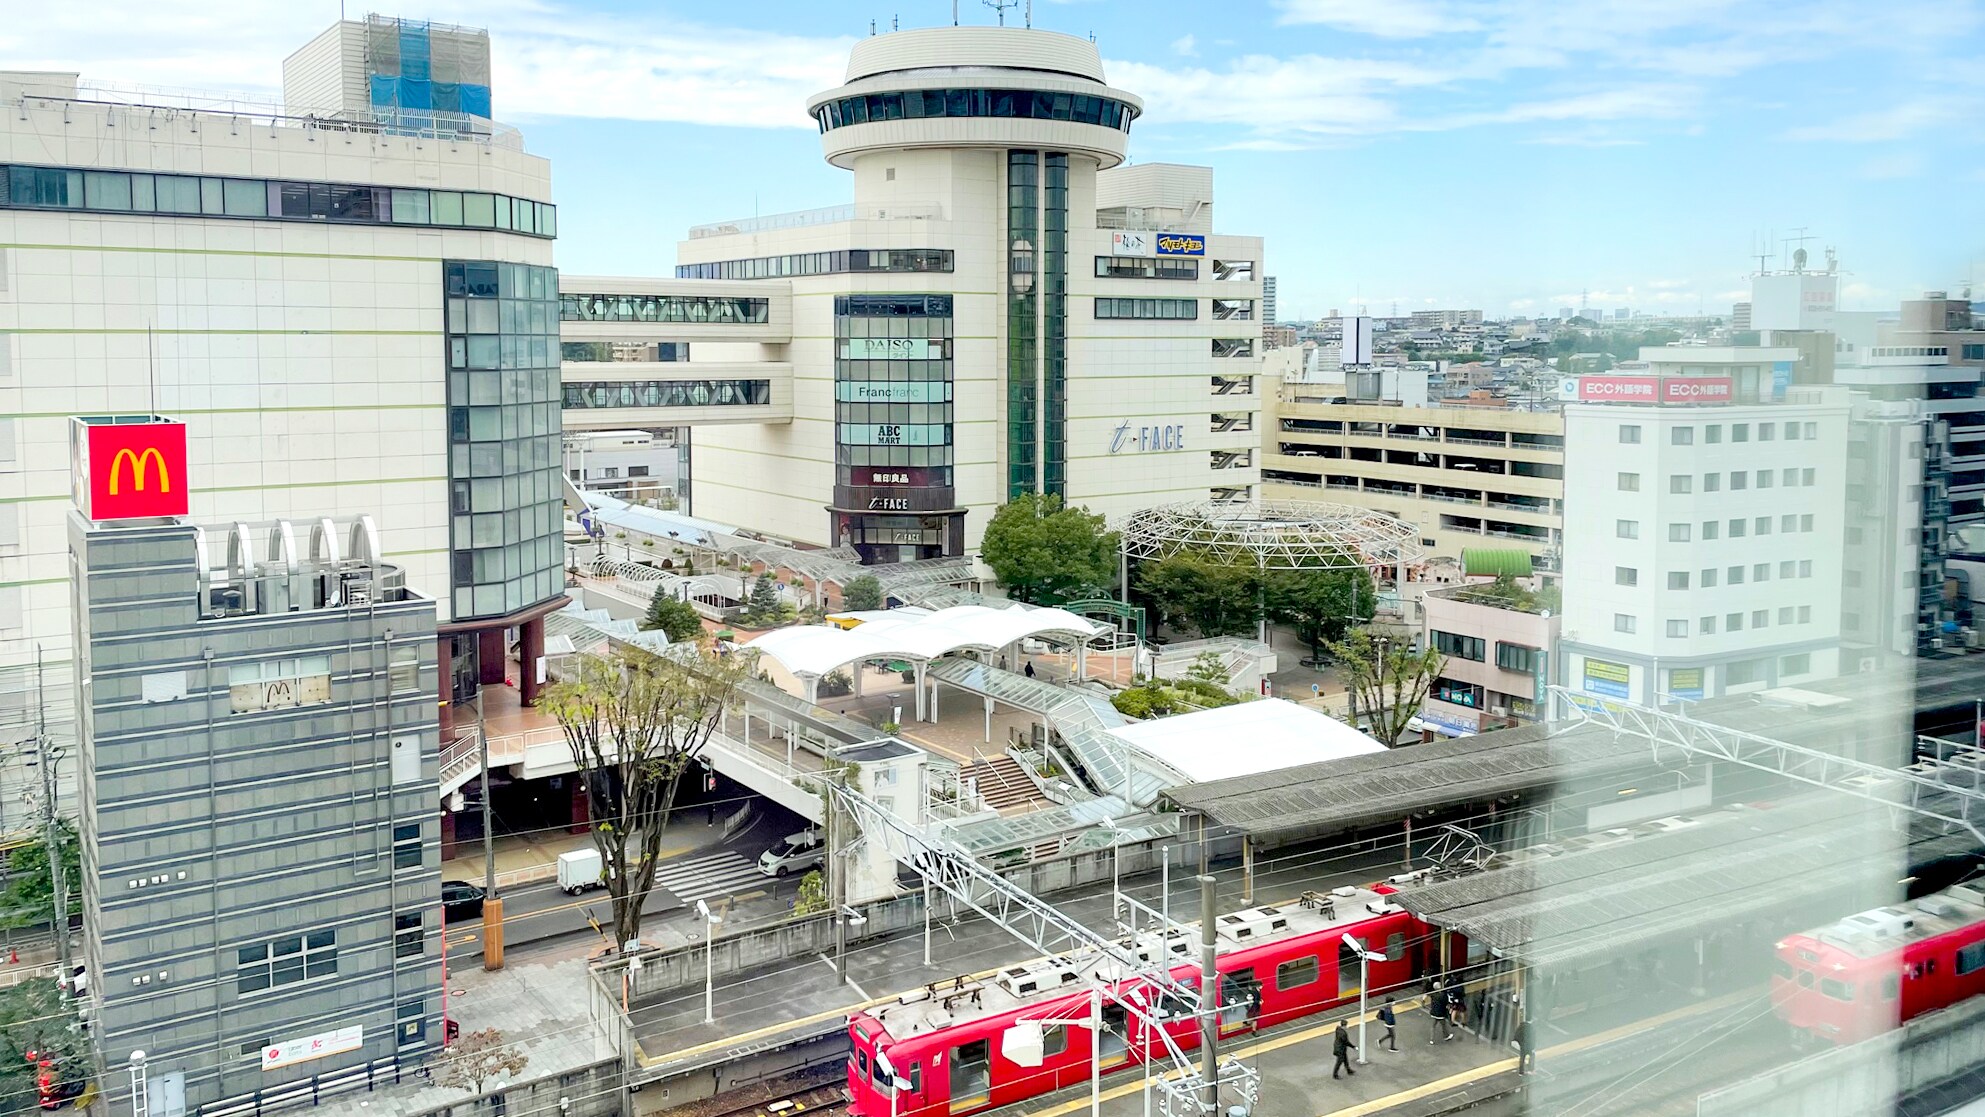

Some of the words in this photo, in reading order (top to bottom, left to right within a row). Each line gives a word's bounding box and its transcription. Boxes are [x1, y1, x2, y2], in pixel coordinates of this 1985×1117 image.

[864, 339, 913, 350] DAISO
[859, 387, 919, 397] Francfranc
[878, 426, 900, 436] ABC
[873, 473, 909, 483] 無印良品
